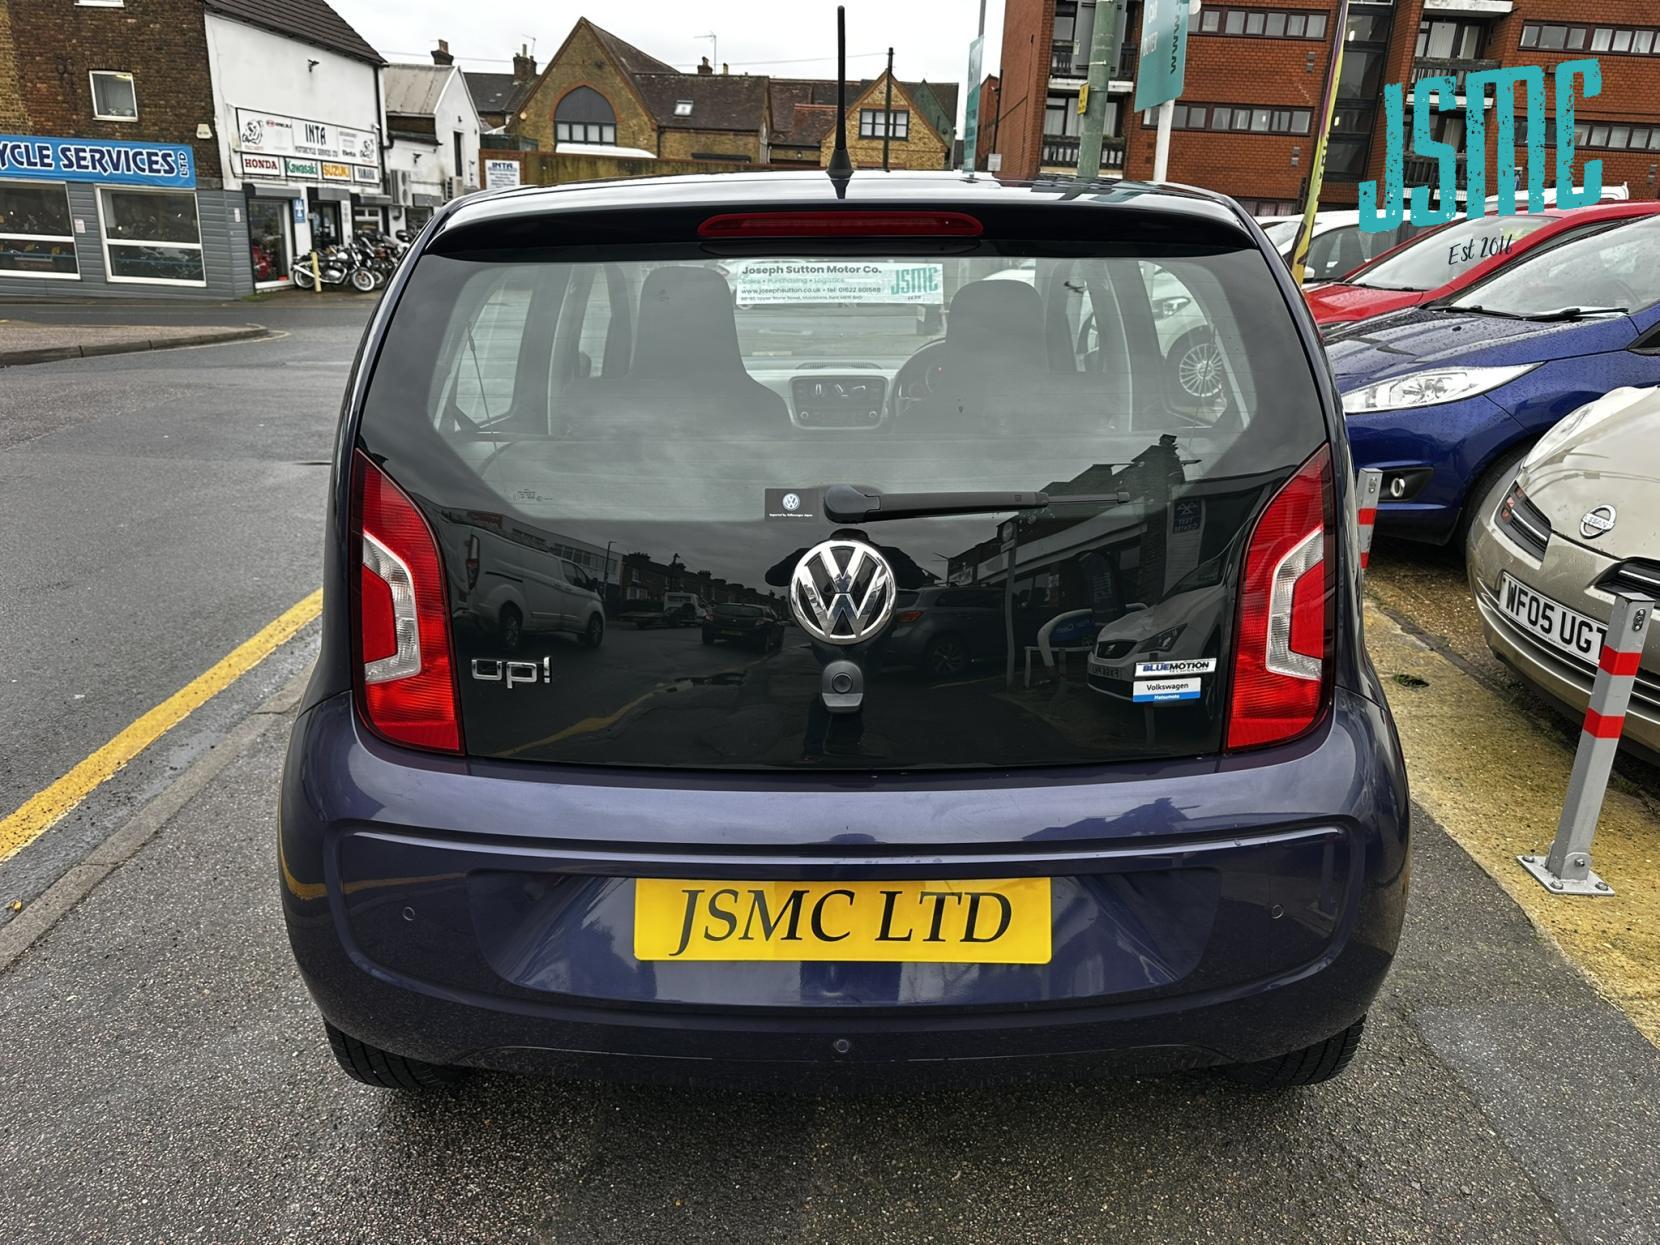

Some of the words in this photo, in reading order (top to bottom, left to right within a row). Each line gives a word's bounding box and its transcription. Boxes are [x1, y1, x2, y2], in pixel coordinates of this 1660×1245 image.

[304, 123, 327, 146] INTA
[58, 145, 177, 177] SERVICES
[178, 151, 190, 178] LTD
[244, 158, 279, 170] HONDA
[286, 160, 318, 175] Kawasaki
[322, 163, 350, 177] SUZUKI
[742, 265, 784, 277] Joseph
[786, 265, 825, 274] Sutton
[827, 265, 861, 274] Motor
[863, 265, 882, 274] Co.
[890, 266, 939, 295] JSMC
[1506, 580, 1554, 634] WF05
[471, 656, 551, 689] up!
[1143, 660, 1210, 673] BLUEMOTION
[1146, 682, 1189, 692] Volkswagen
[668, 888, 856, 957] JSMC
[874, 889, 1013, 944] LTD
